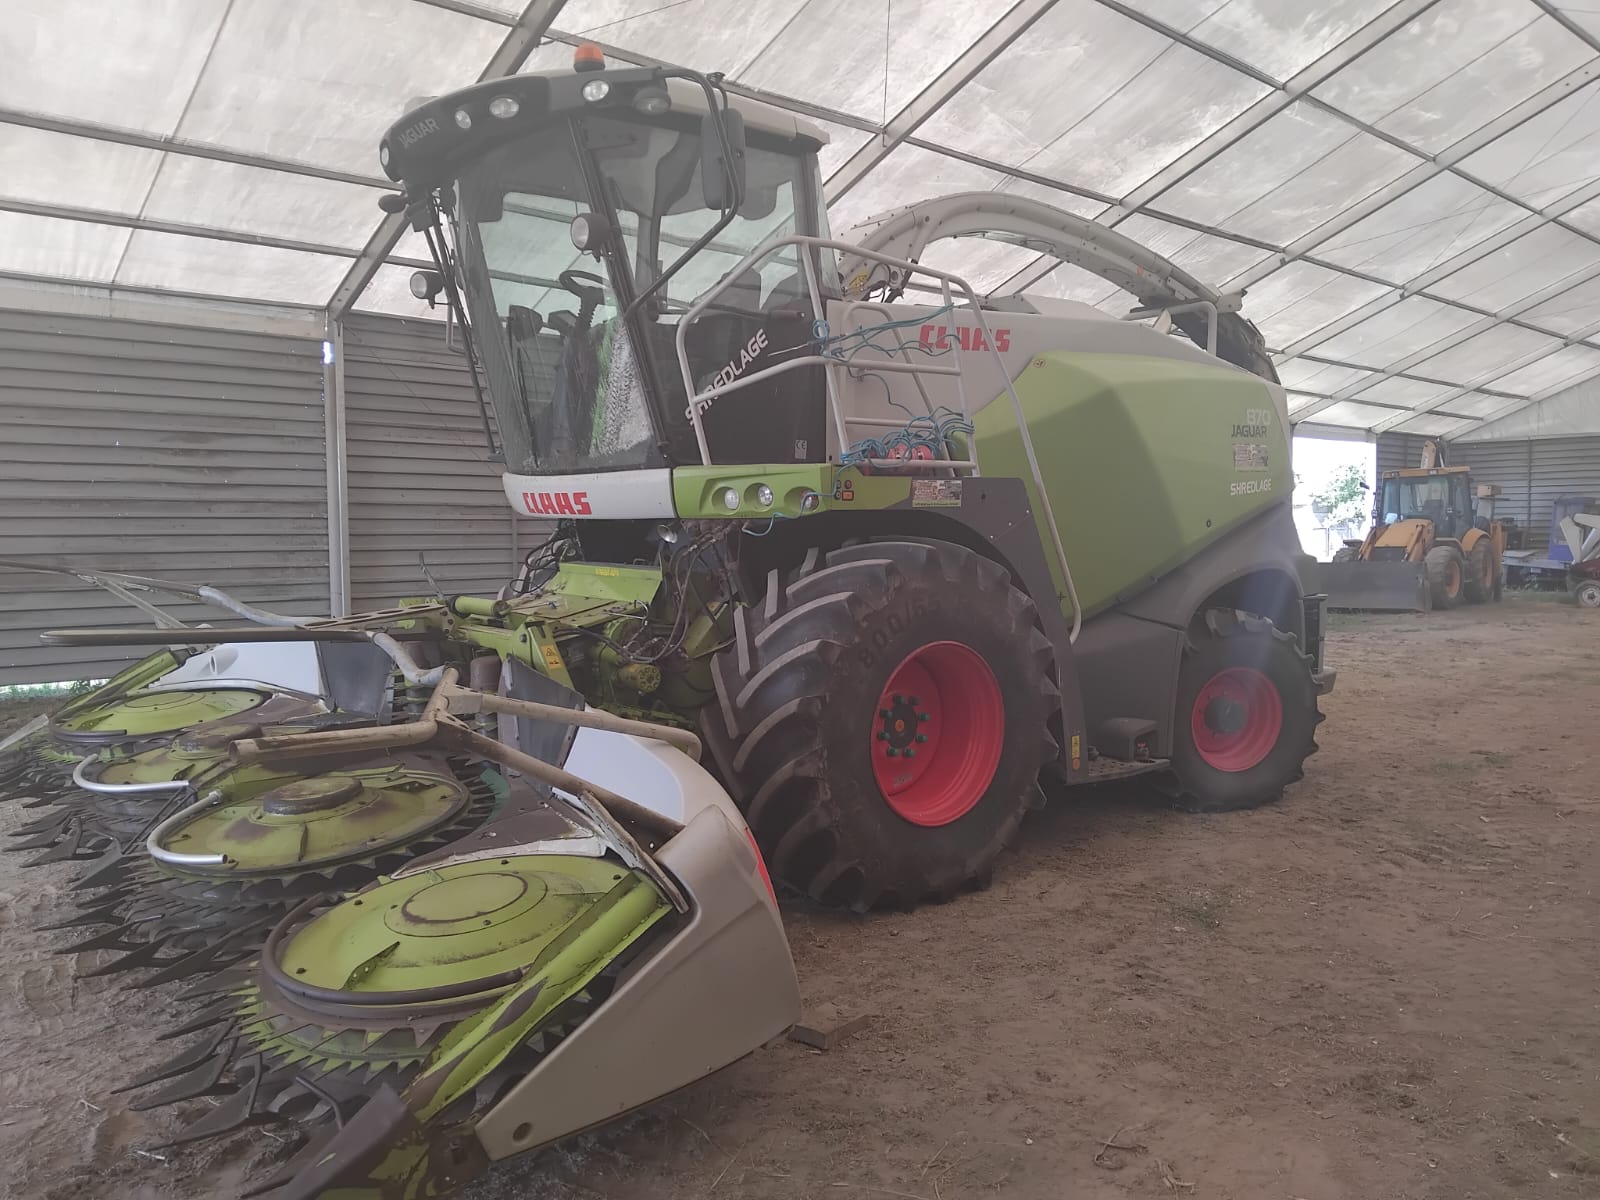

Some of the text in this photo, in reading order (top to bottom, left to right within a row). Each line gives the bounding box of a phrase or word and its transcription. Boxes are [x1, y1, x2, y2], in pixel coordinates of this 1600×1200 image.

[918, 324, 1011, 353] CLAAS
[1231, 425, 1267, 438] JAGUAR
[1230, 479, 1272, 496] SHREDLAGE
[522, 492, 592, 515] CLAAS
